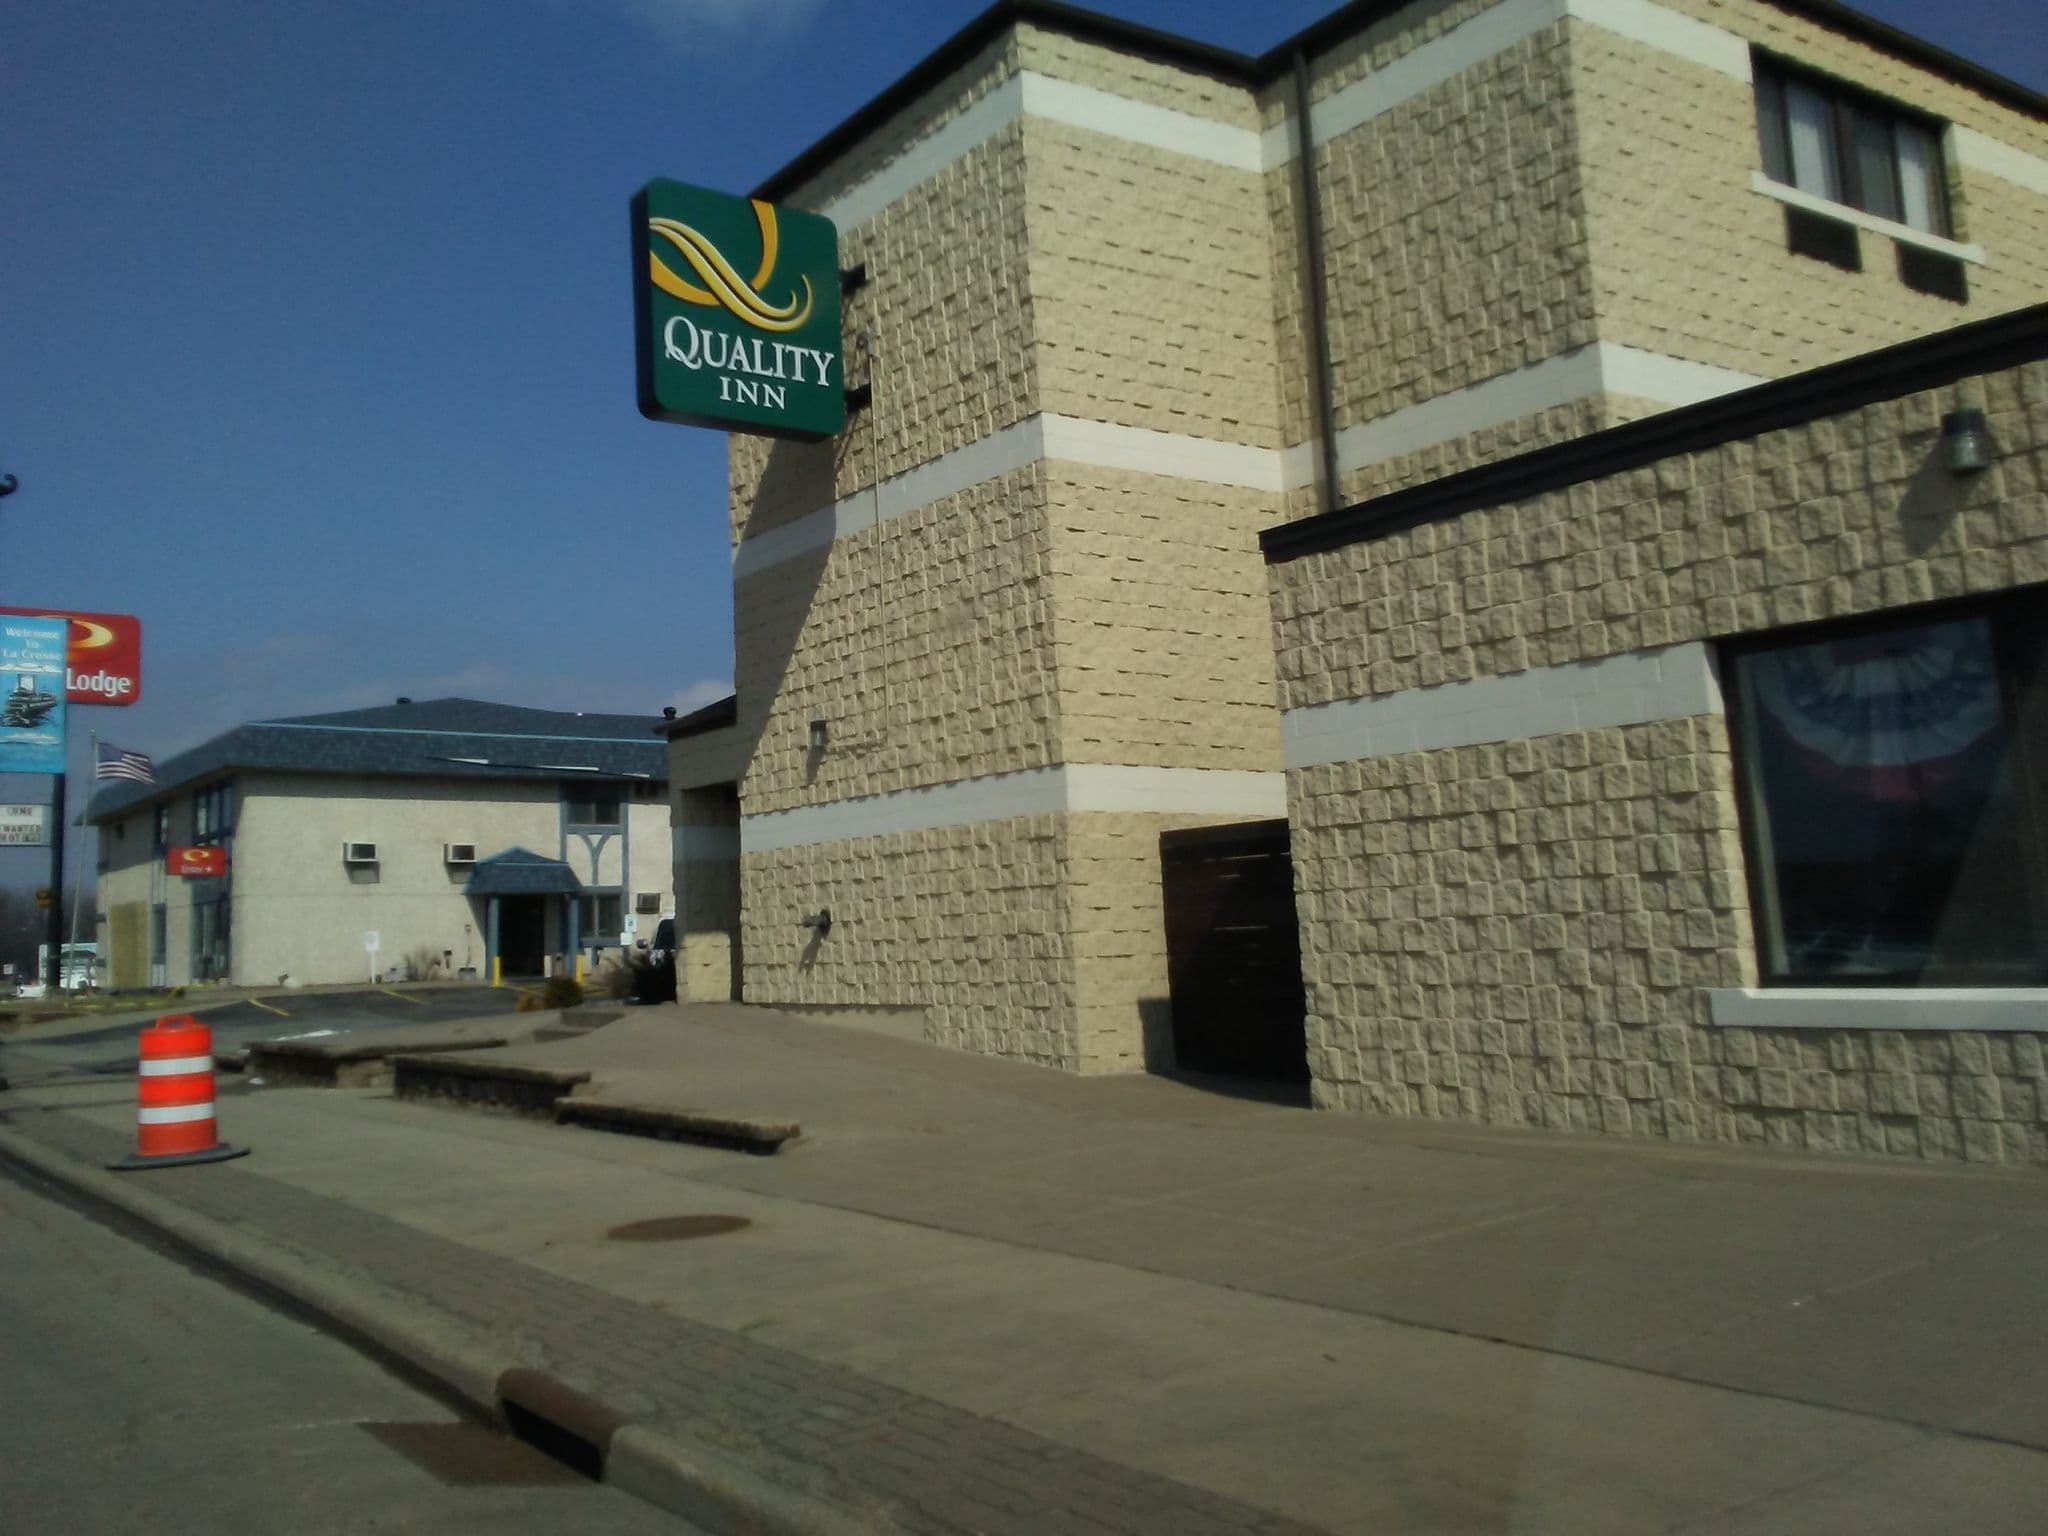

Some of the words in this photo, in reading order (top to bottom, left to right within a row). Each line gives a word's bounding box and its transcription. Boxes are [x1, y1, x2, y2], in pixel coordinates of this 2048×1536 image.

[663, 315, 835, 387] QUALITY
[719, 376, 786, 410] INN
[5, 626, 60, 640] Welcome
[3, 647, 18, 658] La
[21, 648, 62, 661] Crosse
[65, 667, 131, 697] Lodge
